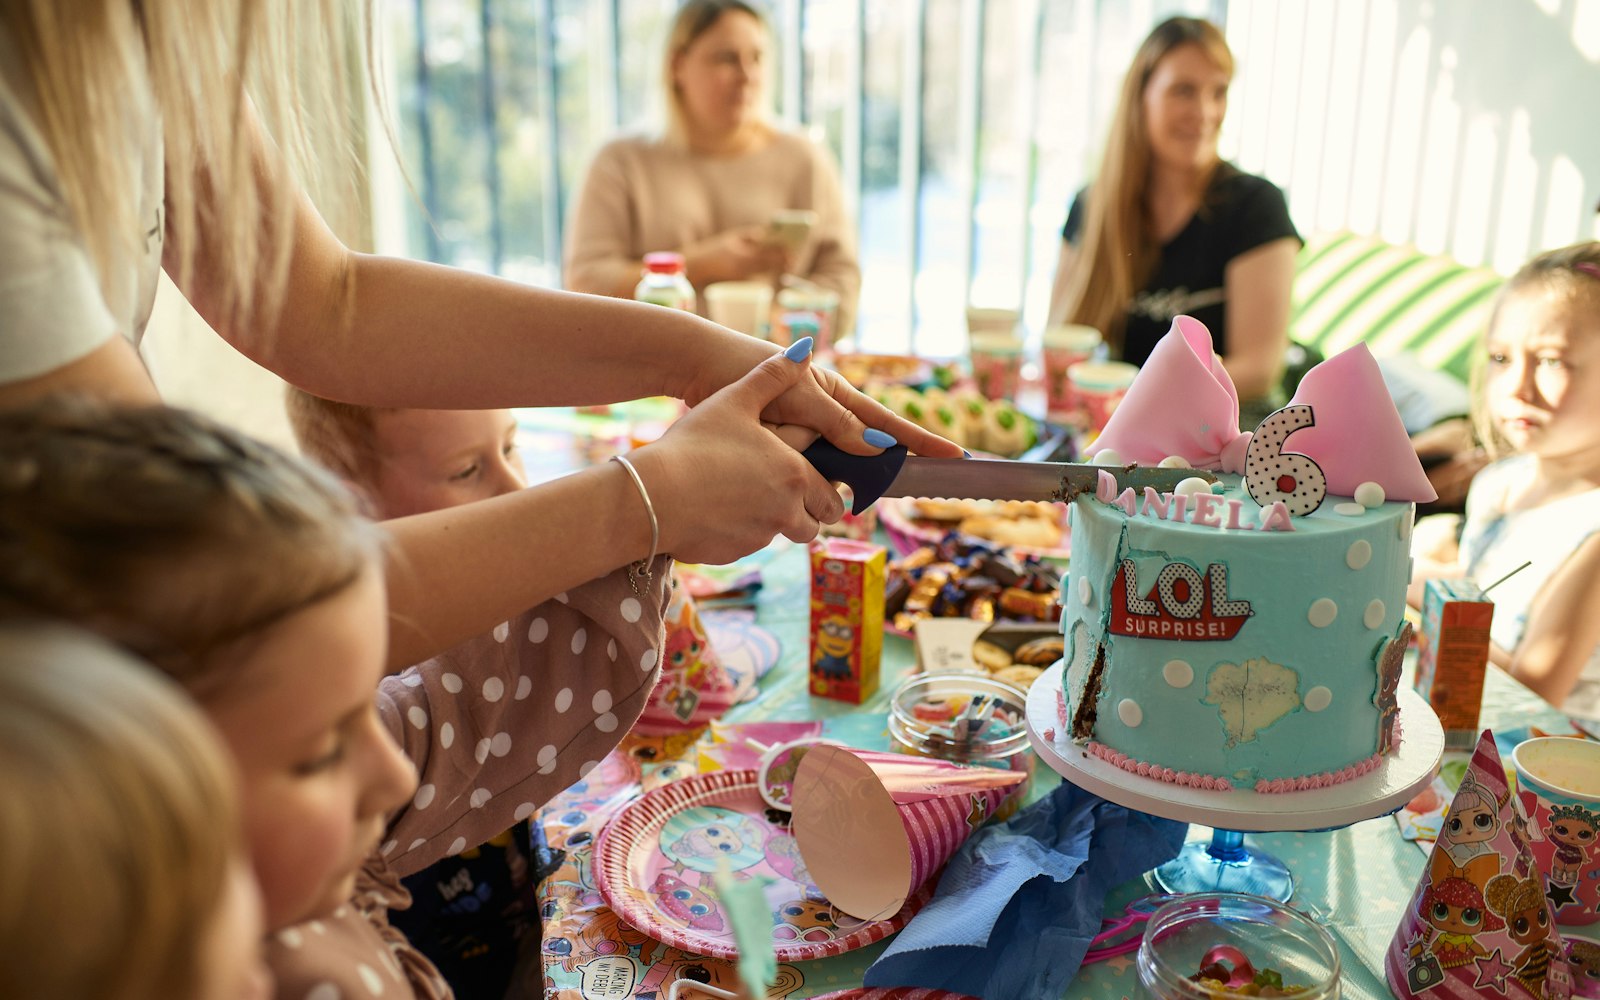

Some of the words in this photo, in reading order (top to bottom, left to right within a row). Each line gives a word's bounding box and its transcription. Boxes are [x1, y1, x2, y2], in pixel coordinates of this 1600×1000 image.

[1245, 404, 1327, 516] 6
[1096, 468, 1296, 531] DANIELA
[1125, 617, 1226, 636] SURPRISE!
[597, 962, 611, 972] MY
[591, 974, 609, 996] DEBUT
[609, 966, 629, 995] MAKING
